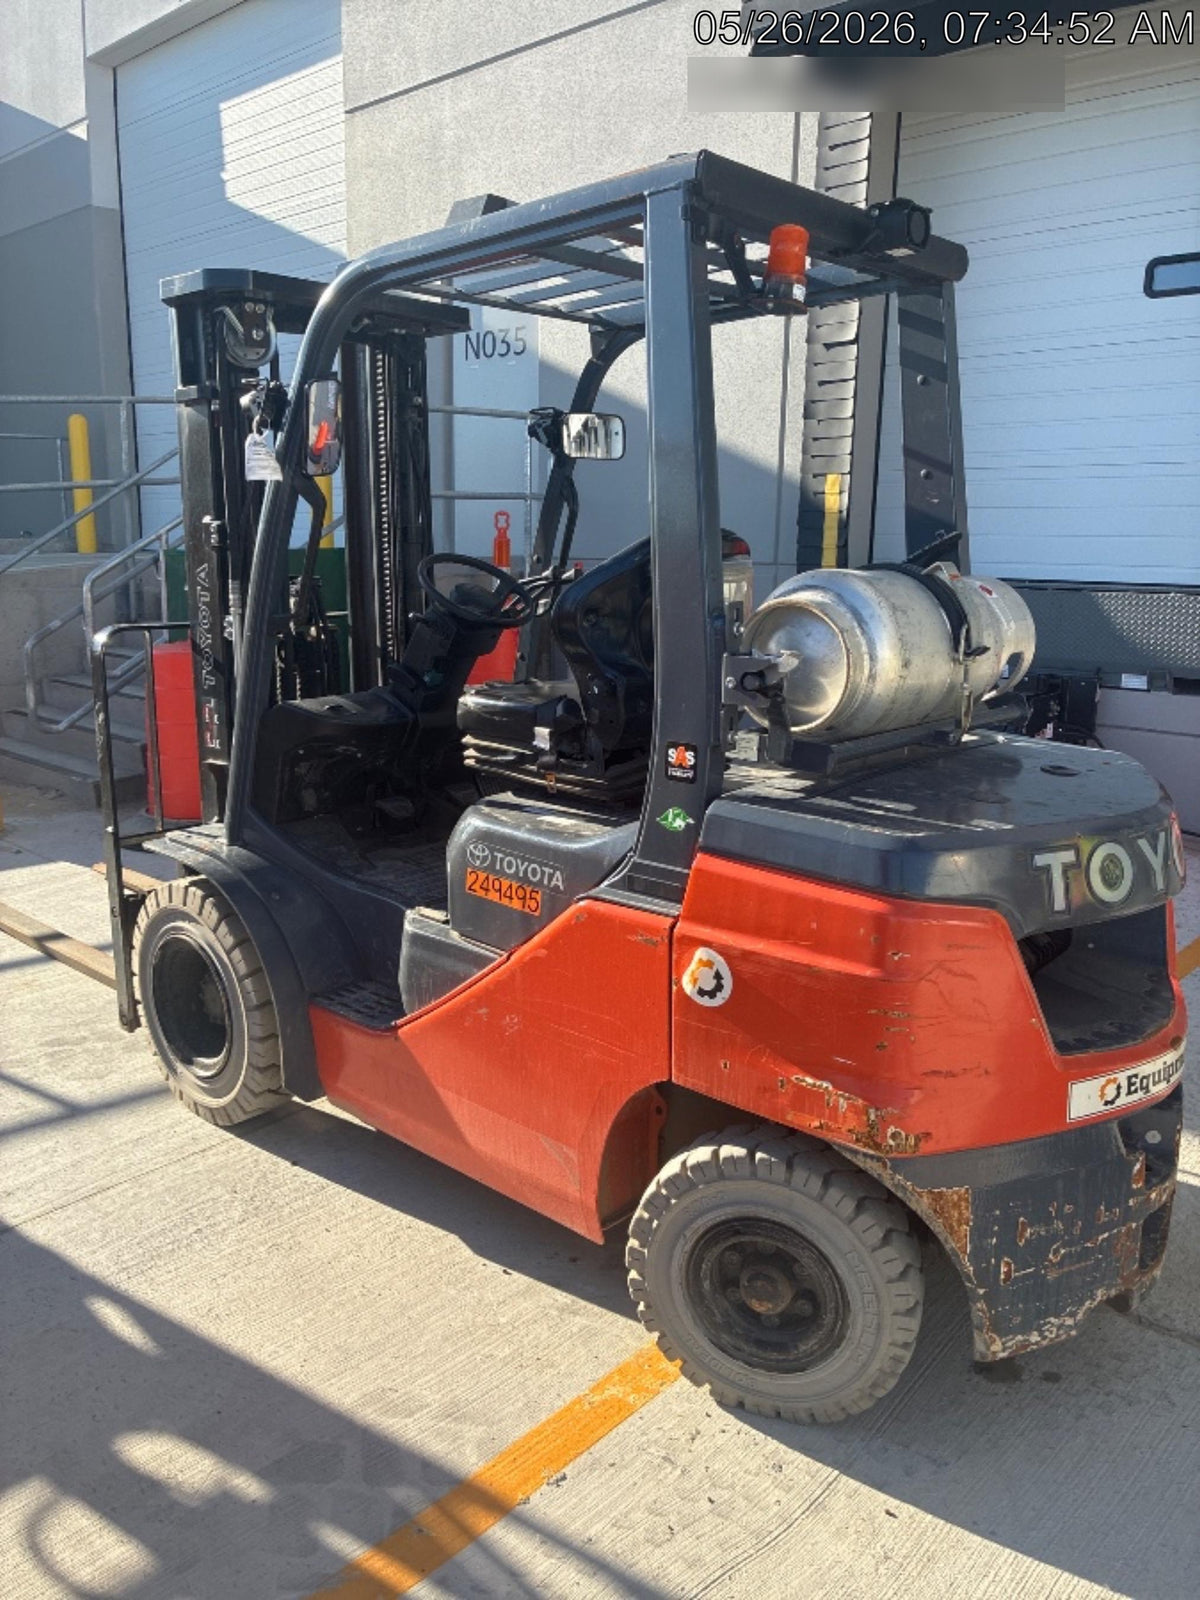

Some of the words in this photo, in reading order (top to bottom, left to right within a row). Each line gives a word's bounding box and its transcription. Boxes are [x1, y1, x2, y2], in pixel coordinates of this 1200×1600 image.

[465, 326, 527, 361] N035
[196, 562, 216, 690] TOYOTA
[667, 745, 696, 769] SAS
[467, 870, 541, 913] 249495
[493, 851, 565, 892] TOYOTA
